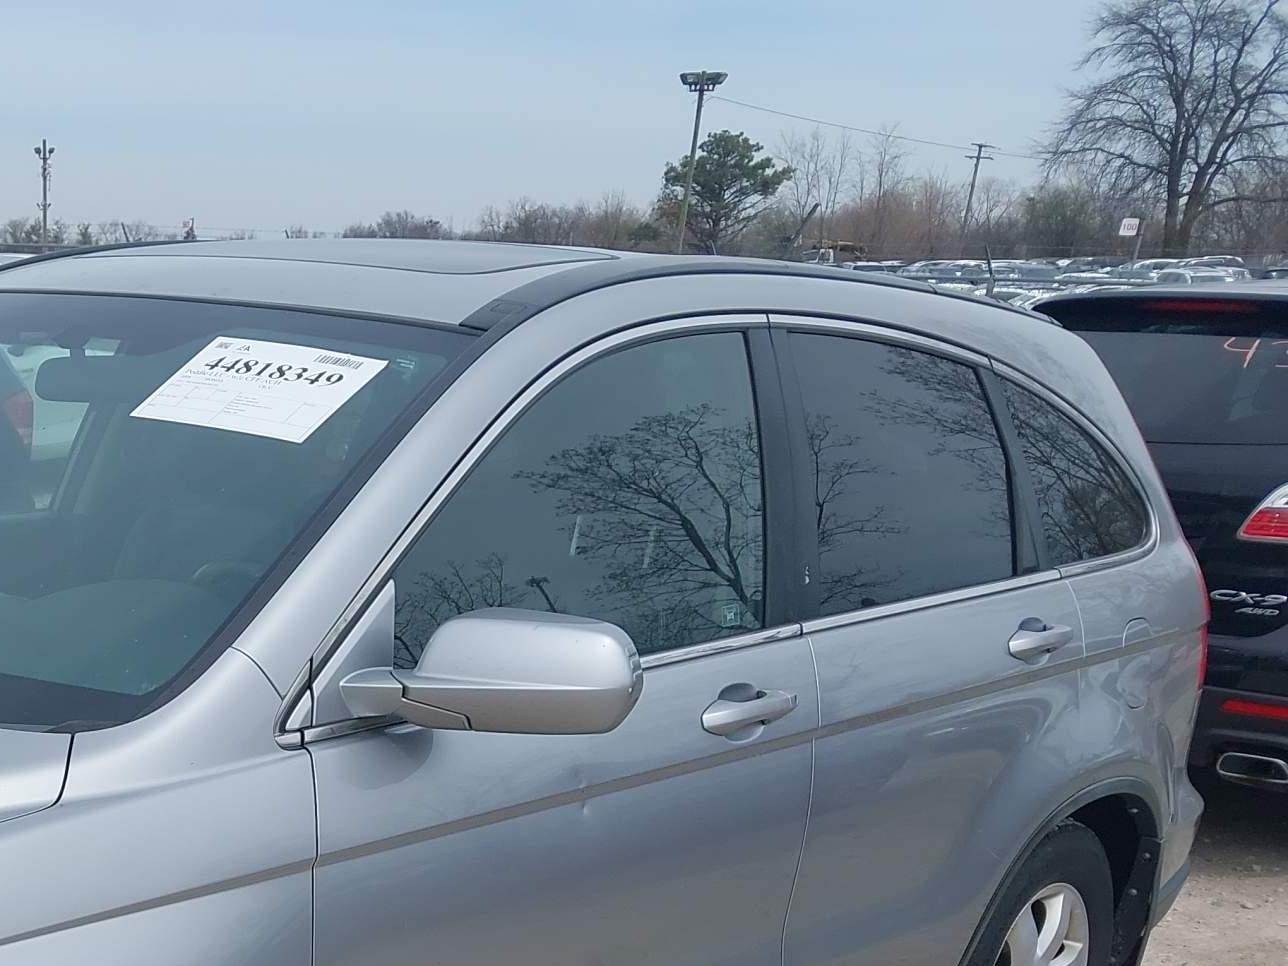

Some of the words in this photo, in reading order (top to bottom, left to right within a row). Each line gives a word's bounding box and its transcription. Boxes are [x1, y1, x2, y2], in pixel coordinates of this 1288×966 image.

[203, 356, 345, 388] 44818349
[1210, 589, 1288, 605] CX-9
[1234, 607, 1280, 616] AWD
